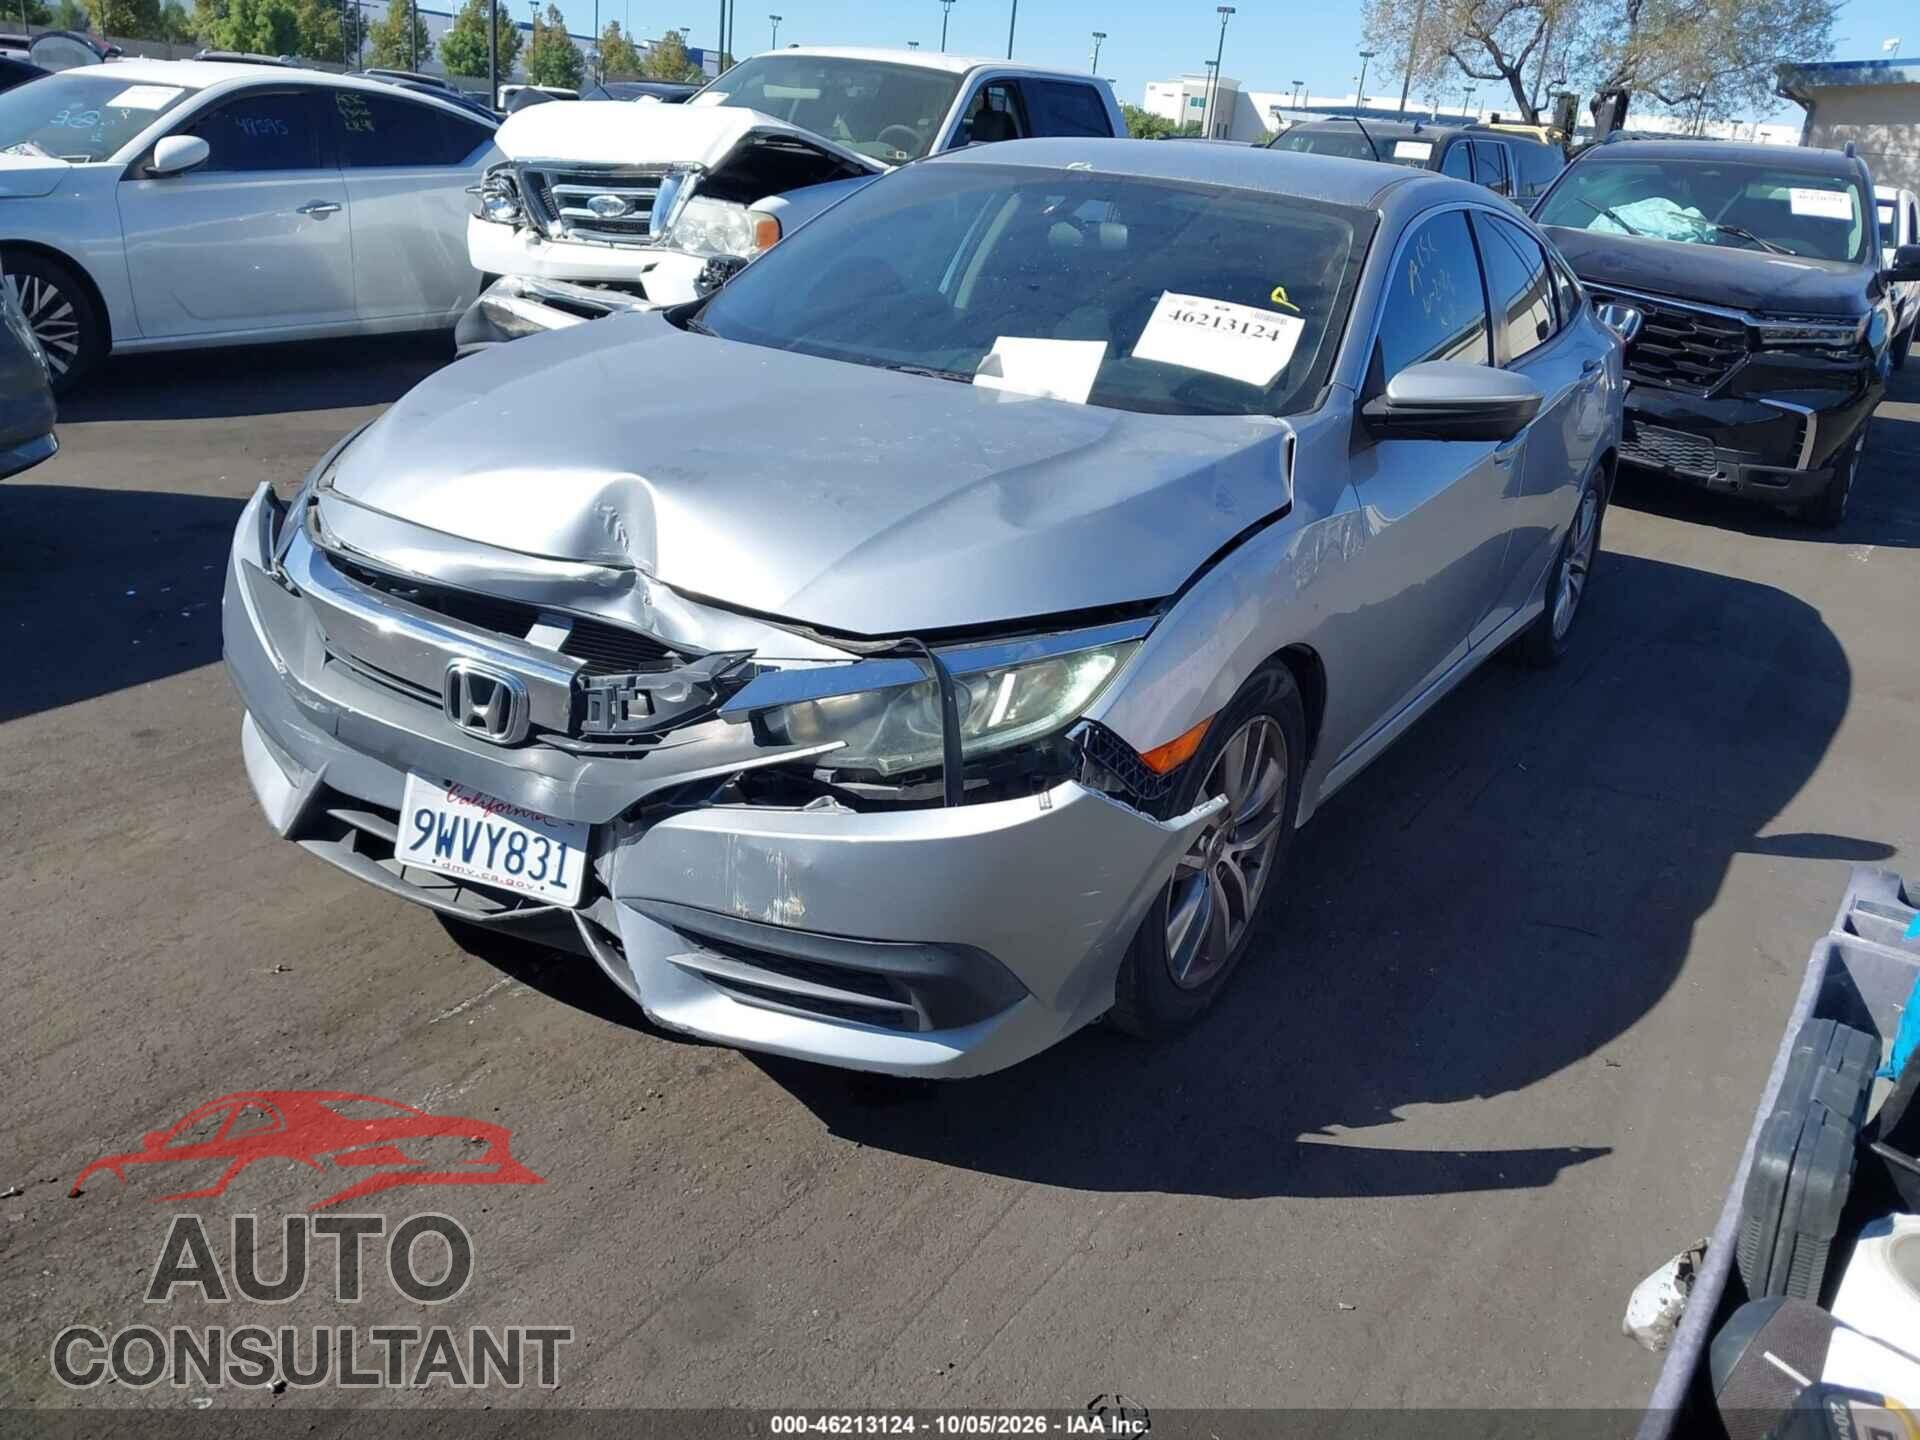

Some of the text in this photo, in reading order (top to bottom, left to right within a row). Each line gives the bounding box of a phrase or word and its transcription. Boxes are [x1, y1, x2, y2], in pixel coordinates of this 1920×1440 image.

[1168, 309, 1280, 342] 46213124
[446, 783, 557, 827] California
[409, 808, 568, 889] 9WVY831
[441, 860, 536, 892] dmv.ca.gov
